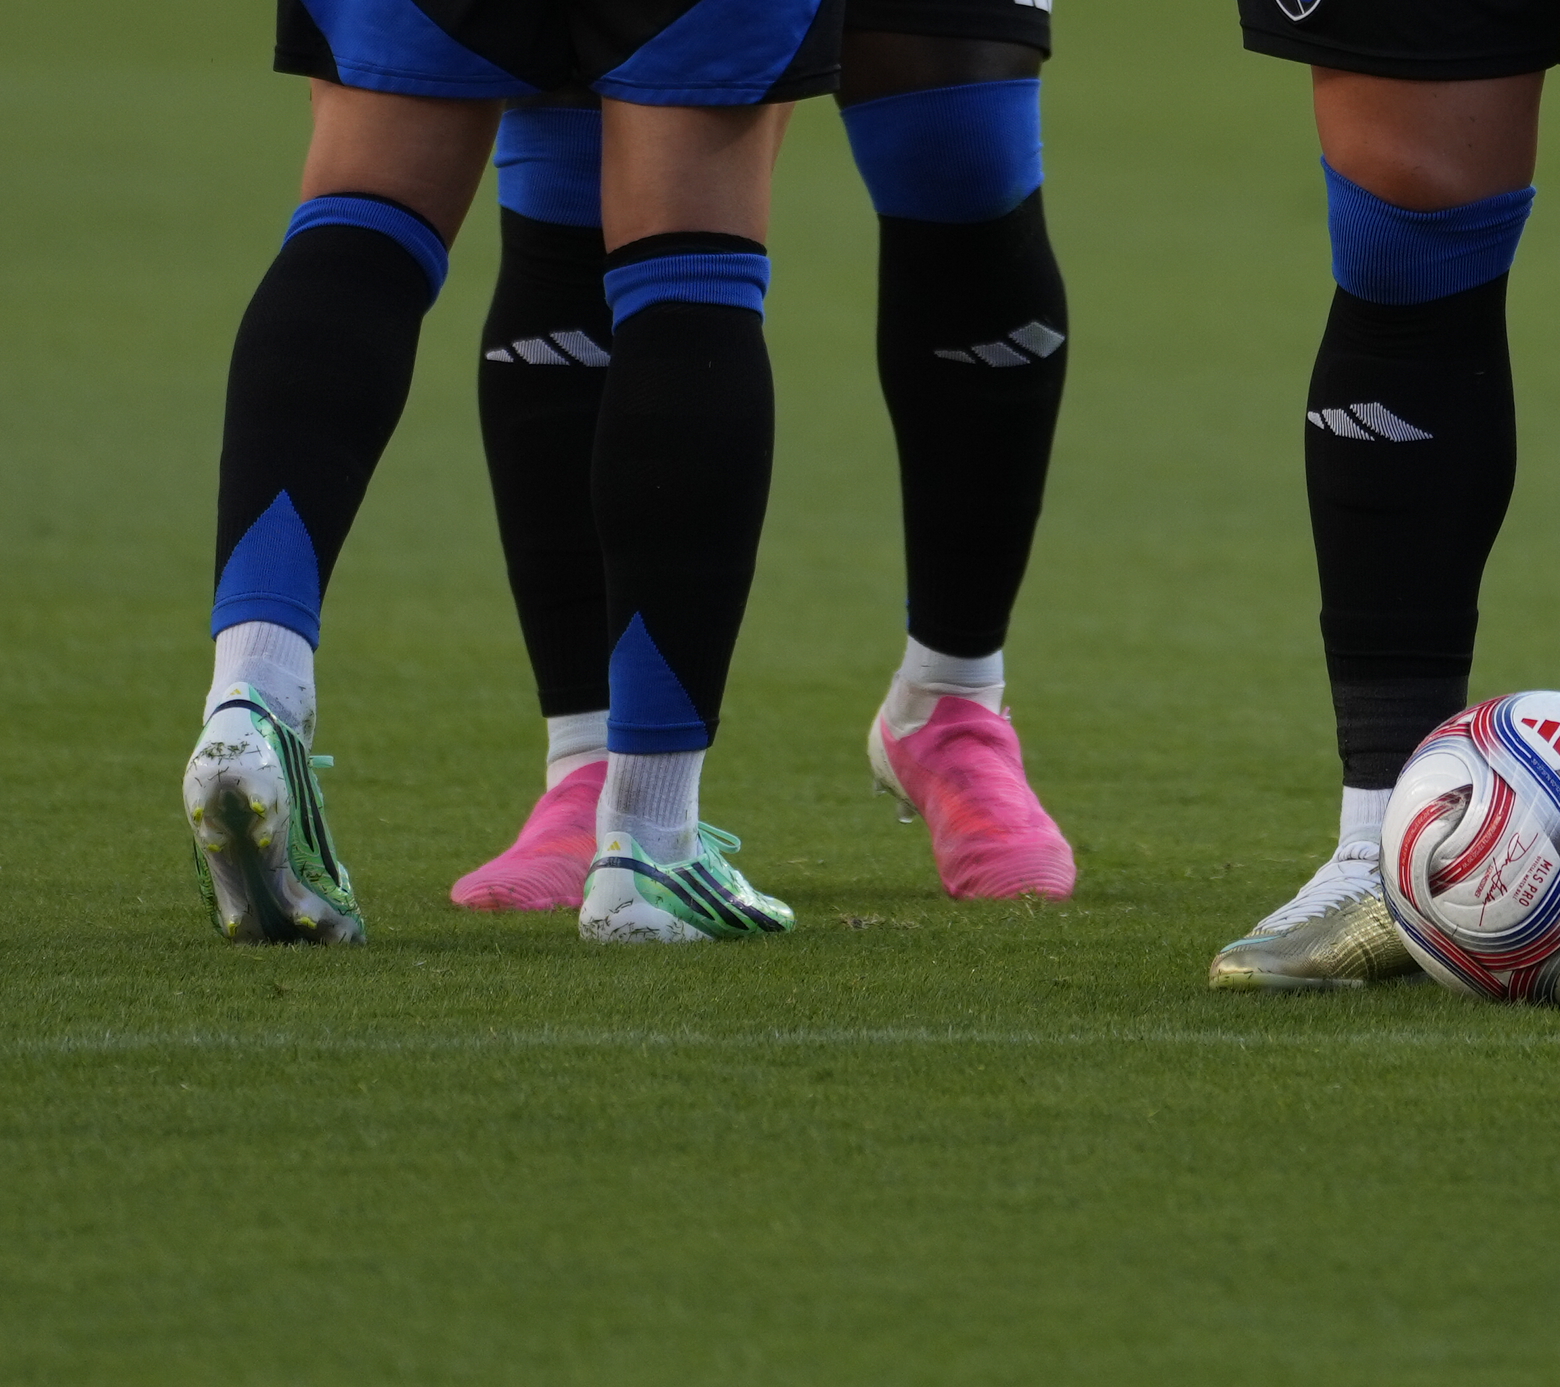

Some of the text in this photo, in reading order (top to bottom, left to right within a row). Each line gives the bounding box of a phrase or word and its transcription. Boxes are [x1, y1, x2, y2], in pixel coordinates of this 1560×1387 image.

[1526, 856, 1542, 874] OFFICIAL
[1519, 859, 1553, 907] MLS PRO
